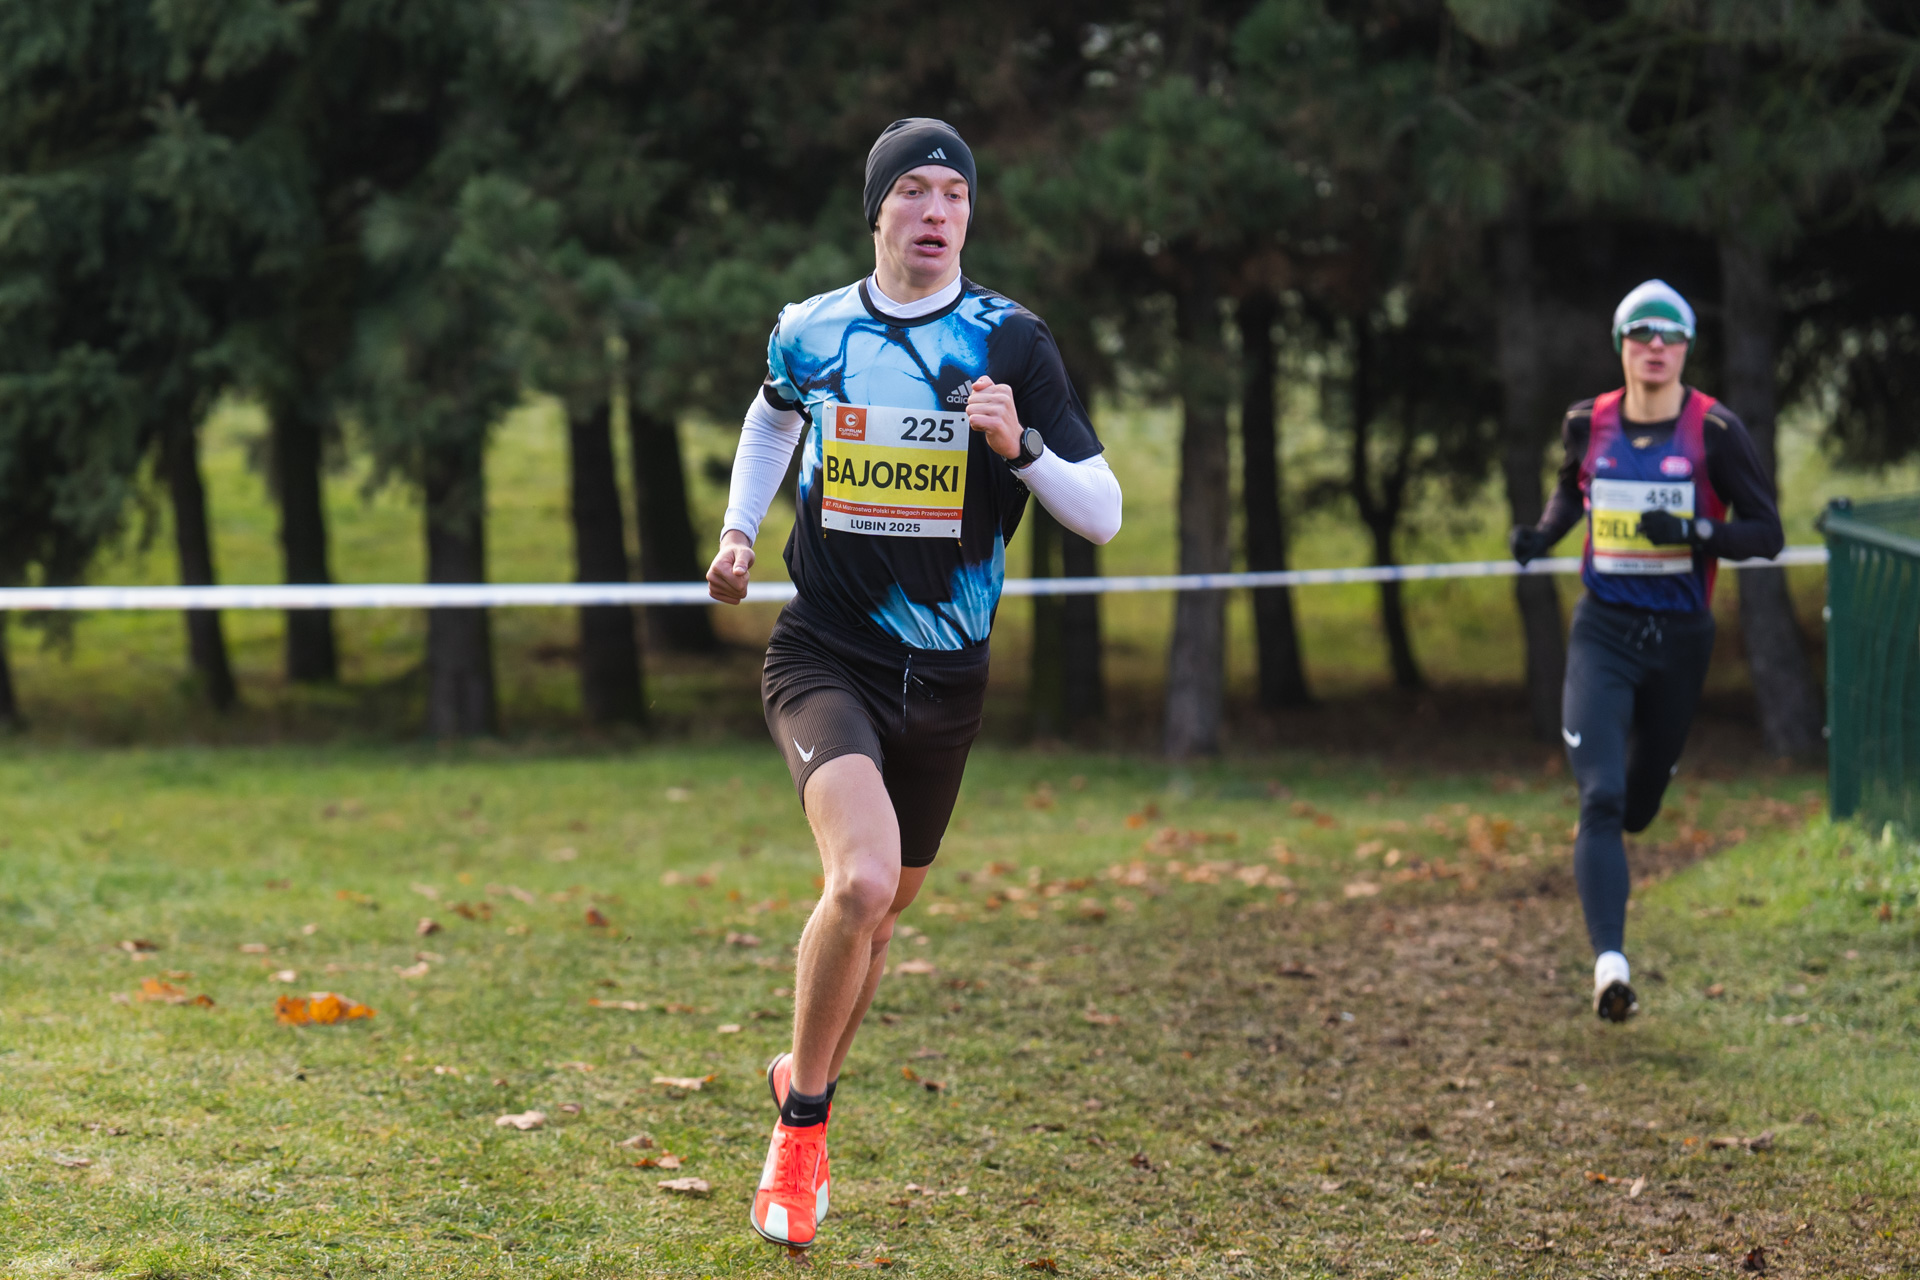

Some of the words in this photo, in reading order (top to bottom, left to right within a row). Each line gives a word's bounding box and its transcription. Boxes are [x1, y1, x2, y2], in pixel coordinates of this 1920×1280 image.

[900, 416, 954, 443] 225
[826, 455, 959, 492] BAJORSKI
[1645, 487, 1683, 507] 458
[842, 504, 872, 514] Mistrzostwa
[872, 507, 890, 515] Polski
[896, 509, 921, 517] Biegach
[921, 510, 958, 518] Przełajowych
[850, 519, 886, 531] LUBIN
[889, 522, 921, 533] 2025
